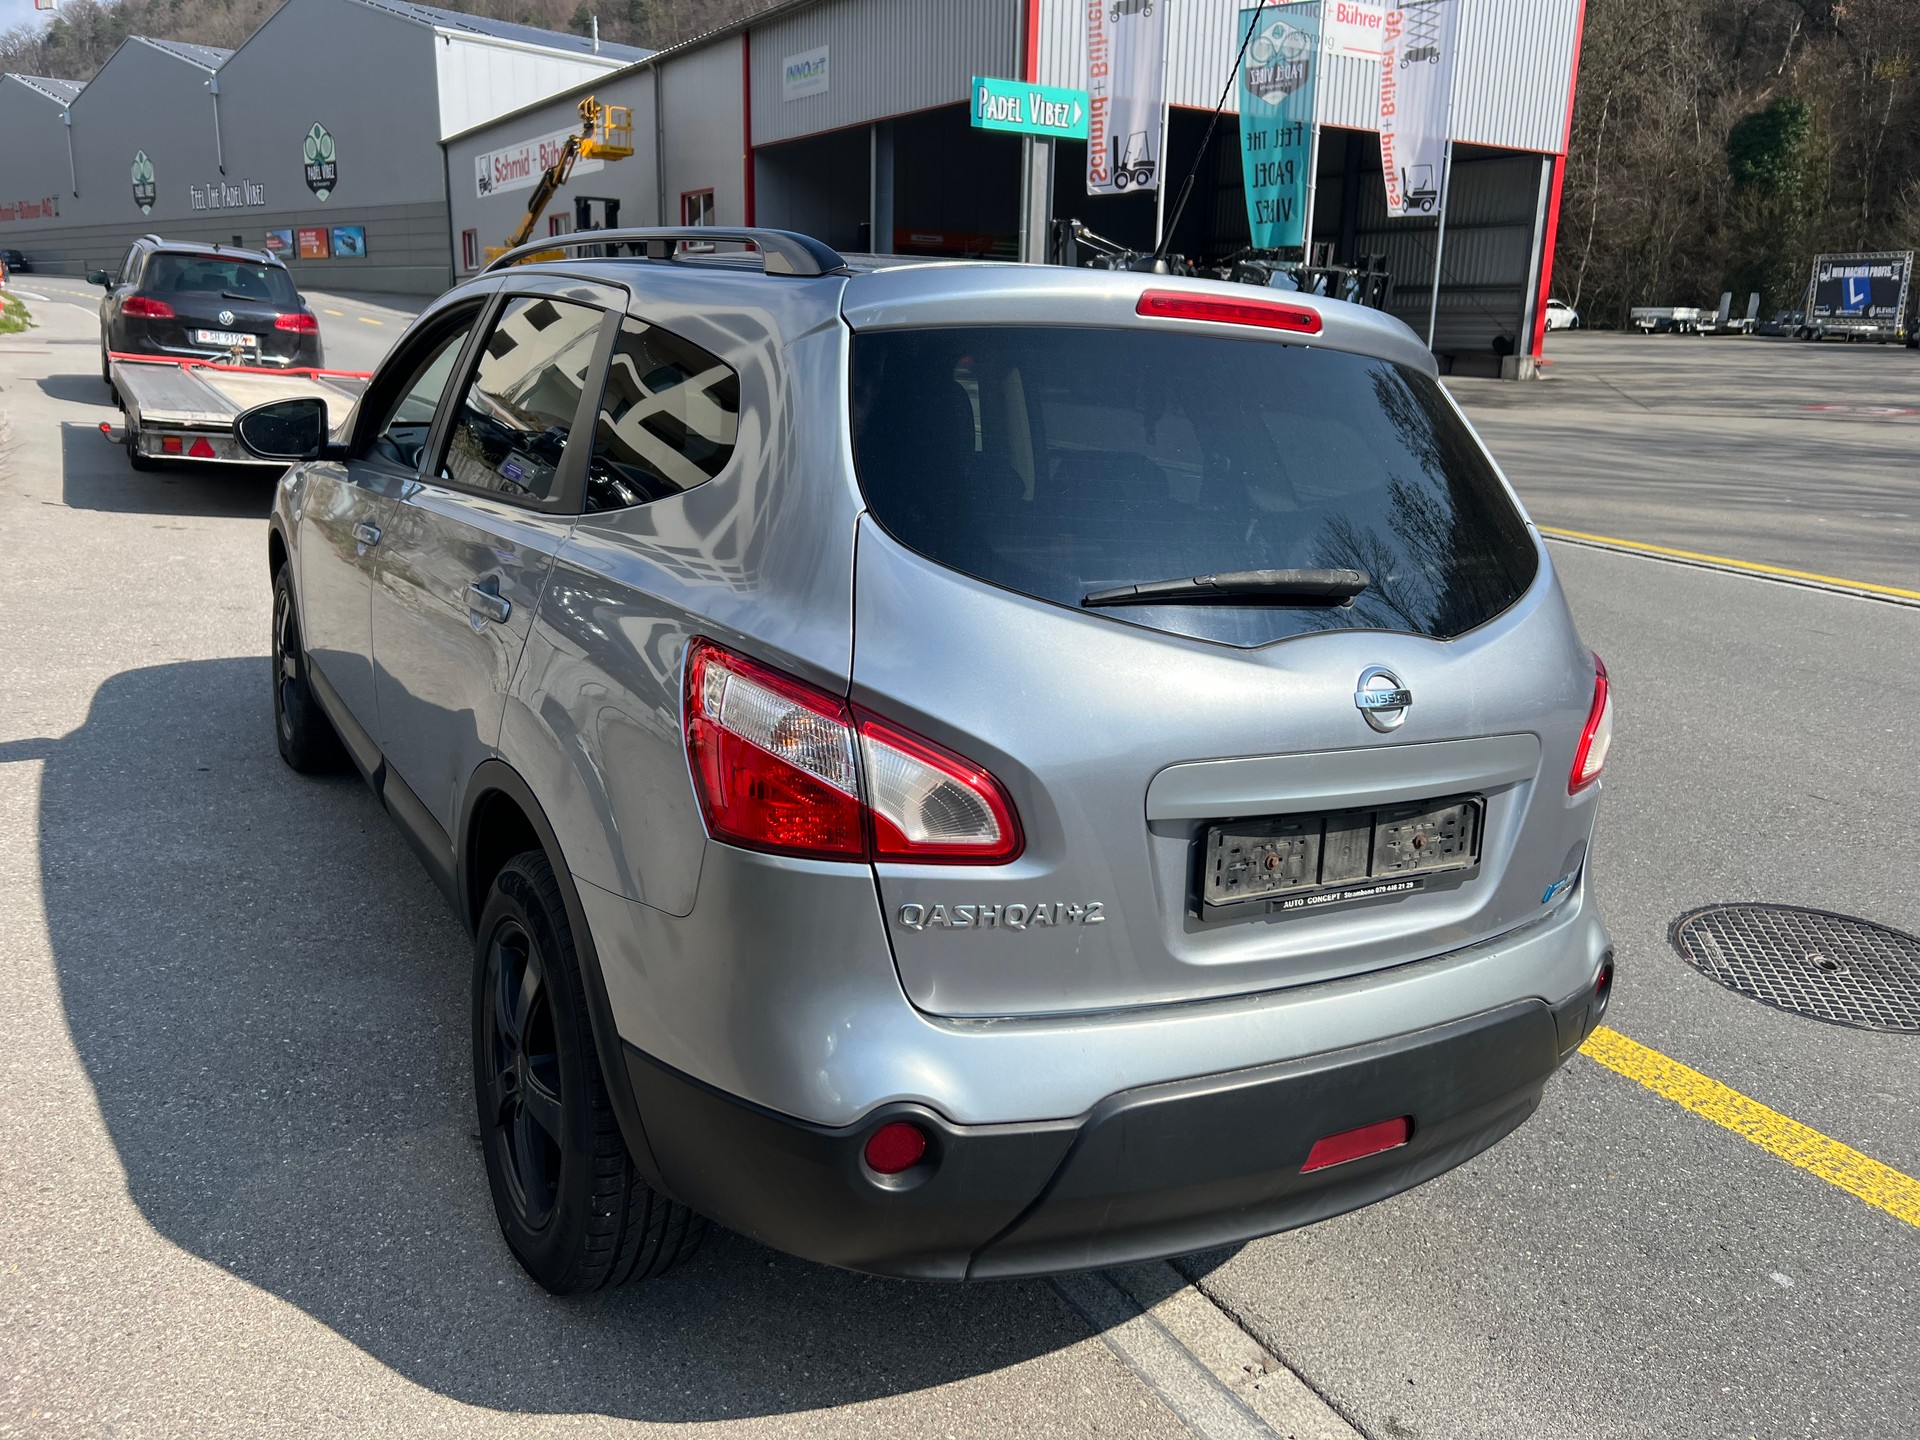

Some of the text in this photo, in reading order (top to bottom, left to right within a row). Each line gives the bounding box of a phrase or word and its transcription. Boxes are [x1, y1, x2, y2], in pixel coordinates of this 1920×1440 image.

[1336, 3, 1383, 29] Bührer
[977, 86, 1071, 129] PADEL VIBEZ
[494, 147, 531, 184] Schmid
[206, 182, 220, 210] THE
[221, 181, 243, 208] PADEL
[243, 178, 265, 206] VIBEZ
[1849, 277, 1864, 305] L
[1365, 693, 1410, 705] NISSAN
[1283, 897, 1304, 909] AUTO
[1307, 891, 1341, 905] CONCEPT
[899, 902, 1106, 931] QASHQAI+2
